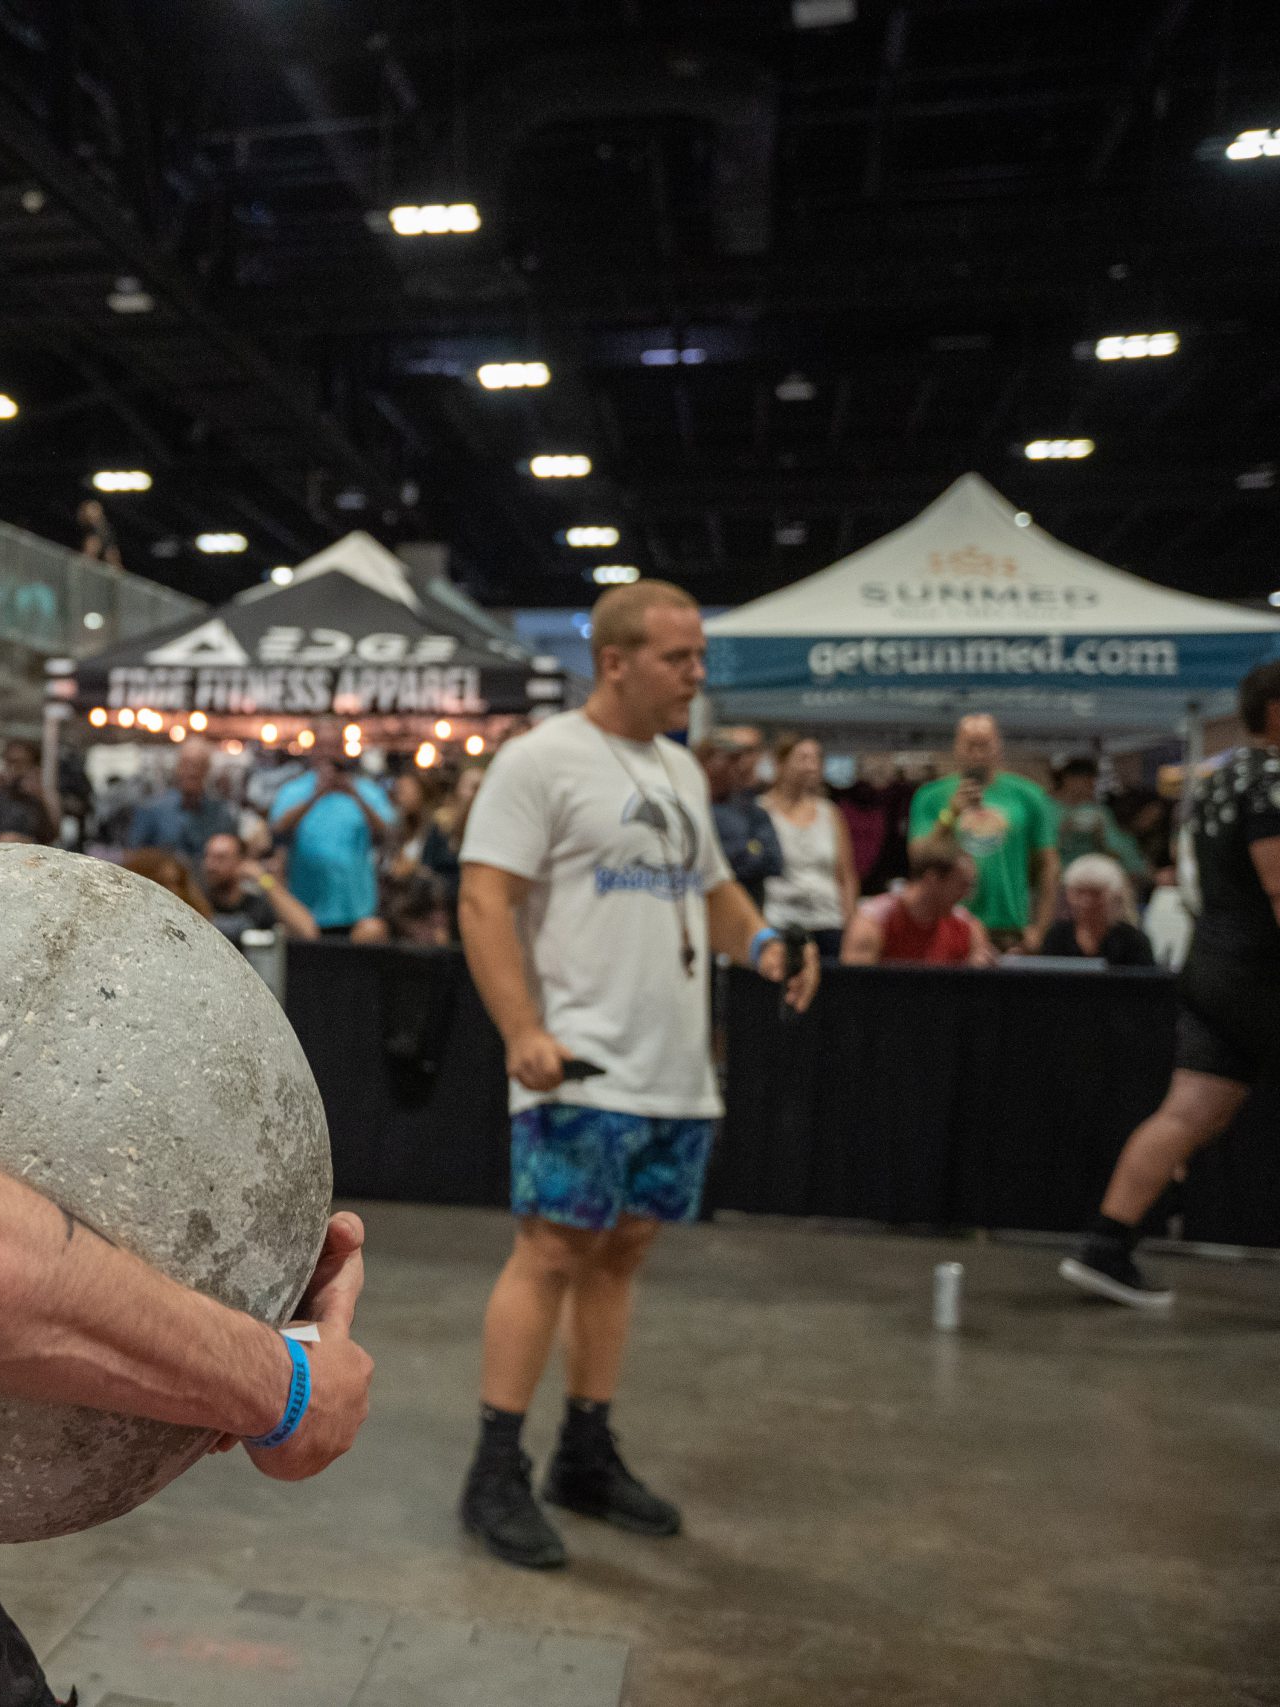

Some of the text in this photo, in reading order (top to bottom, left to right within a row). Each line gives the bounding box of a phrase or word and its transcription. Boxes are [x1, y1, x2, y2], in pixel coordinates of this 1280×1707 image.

[258, 625, 458, 664] EDGE
[808, 636, 1179, 684] getsunmed.com
[195, 667, 331, 712] FITNESS
[333, 667, 486, 713] APPAREL
